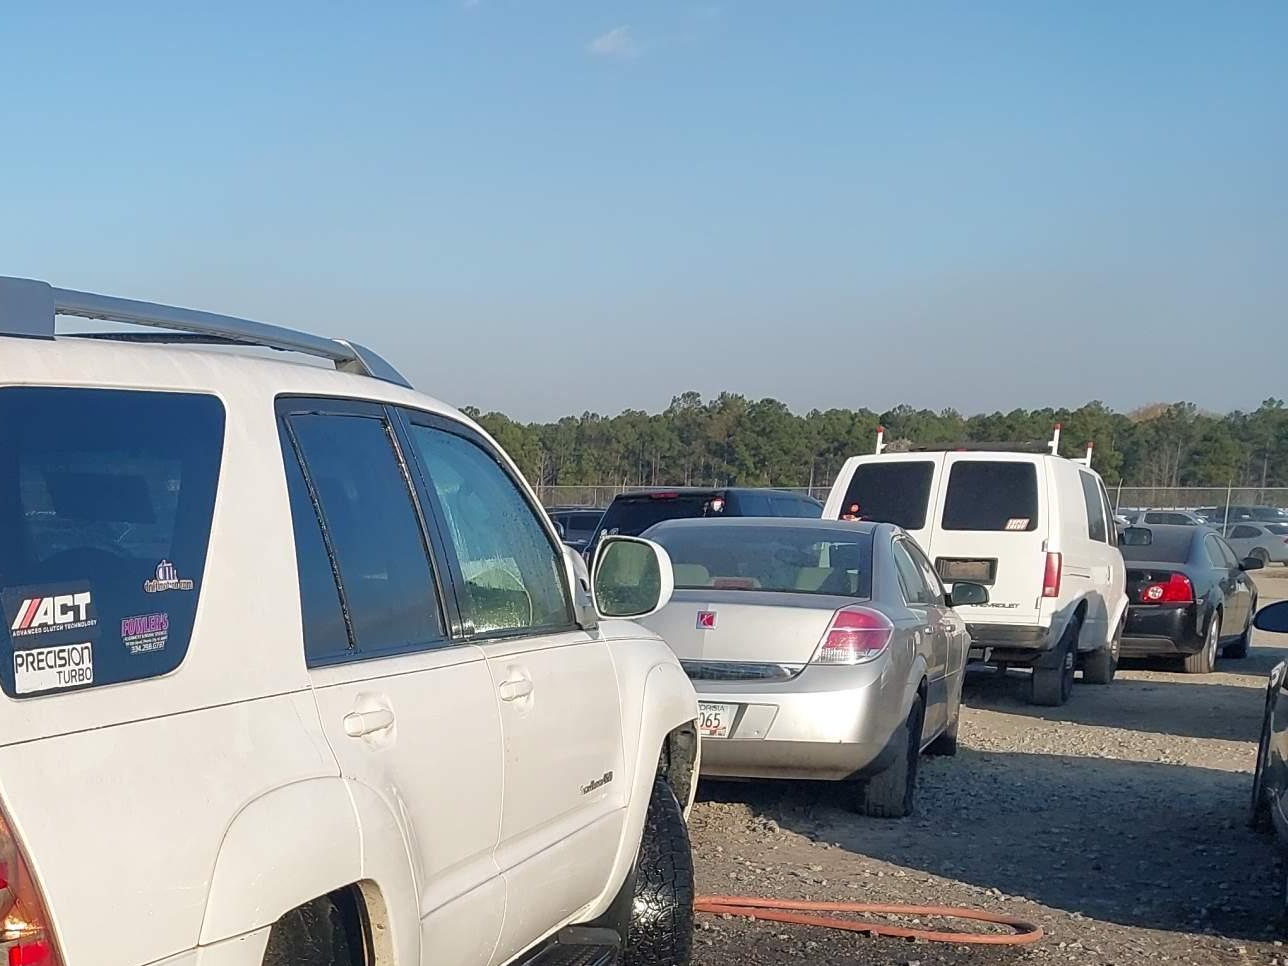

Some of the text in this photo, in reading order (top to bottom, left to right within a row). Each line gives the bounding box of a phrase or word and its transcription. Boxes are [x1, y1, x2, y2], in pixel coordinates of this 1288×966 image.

[32, 592, 91, 628] ACT
[13, 619, 97, 637] ADVANCED CLUTCH TECHNOLOGY
[56, 667, 92, 685] TURBO
